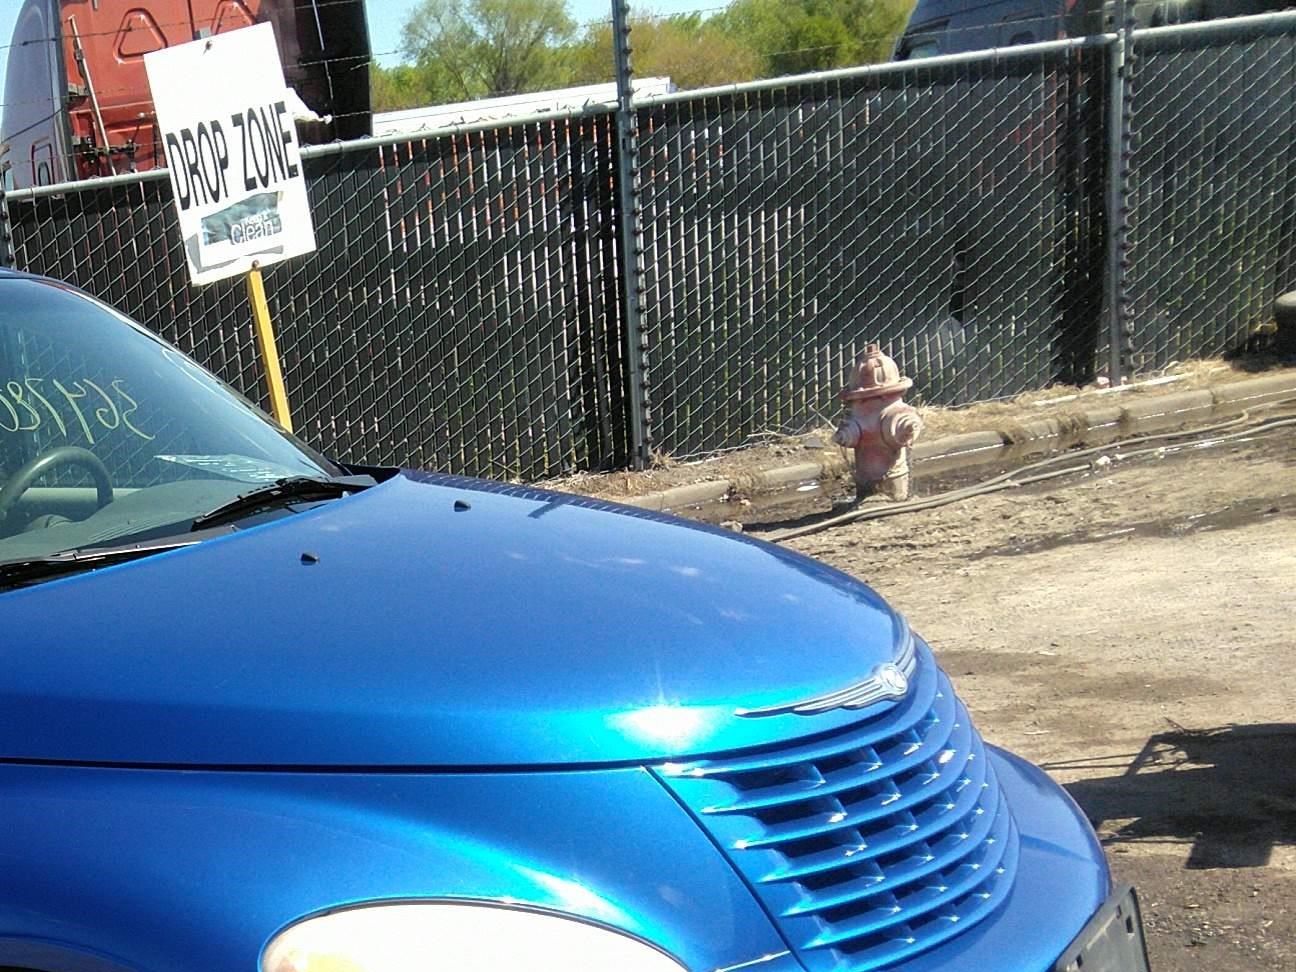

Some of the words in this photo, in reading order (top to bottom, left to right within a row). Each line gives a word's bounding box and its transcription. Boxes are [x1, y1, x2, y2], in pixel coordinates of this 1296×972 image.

[165, 119, 229, 210] DROP
[231, 101, 299, 192] ZONE
[230, 219, 274, 246] Clean
